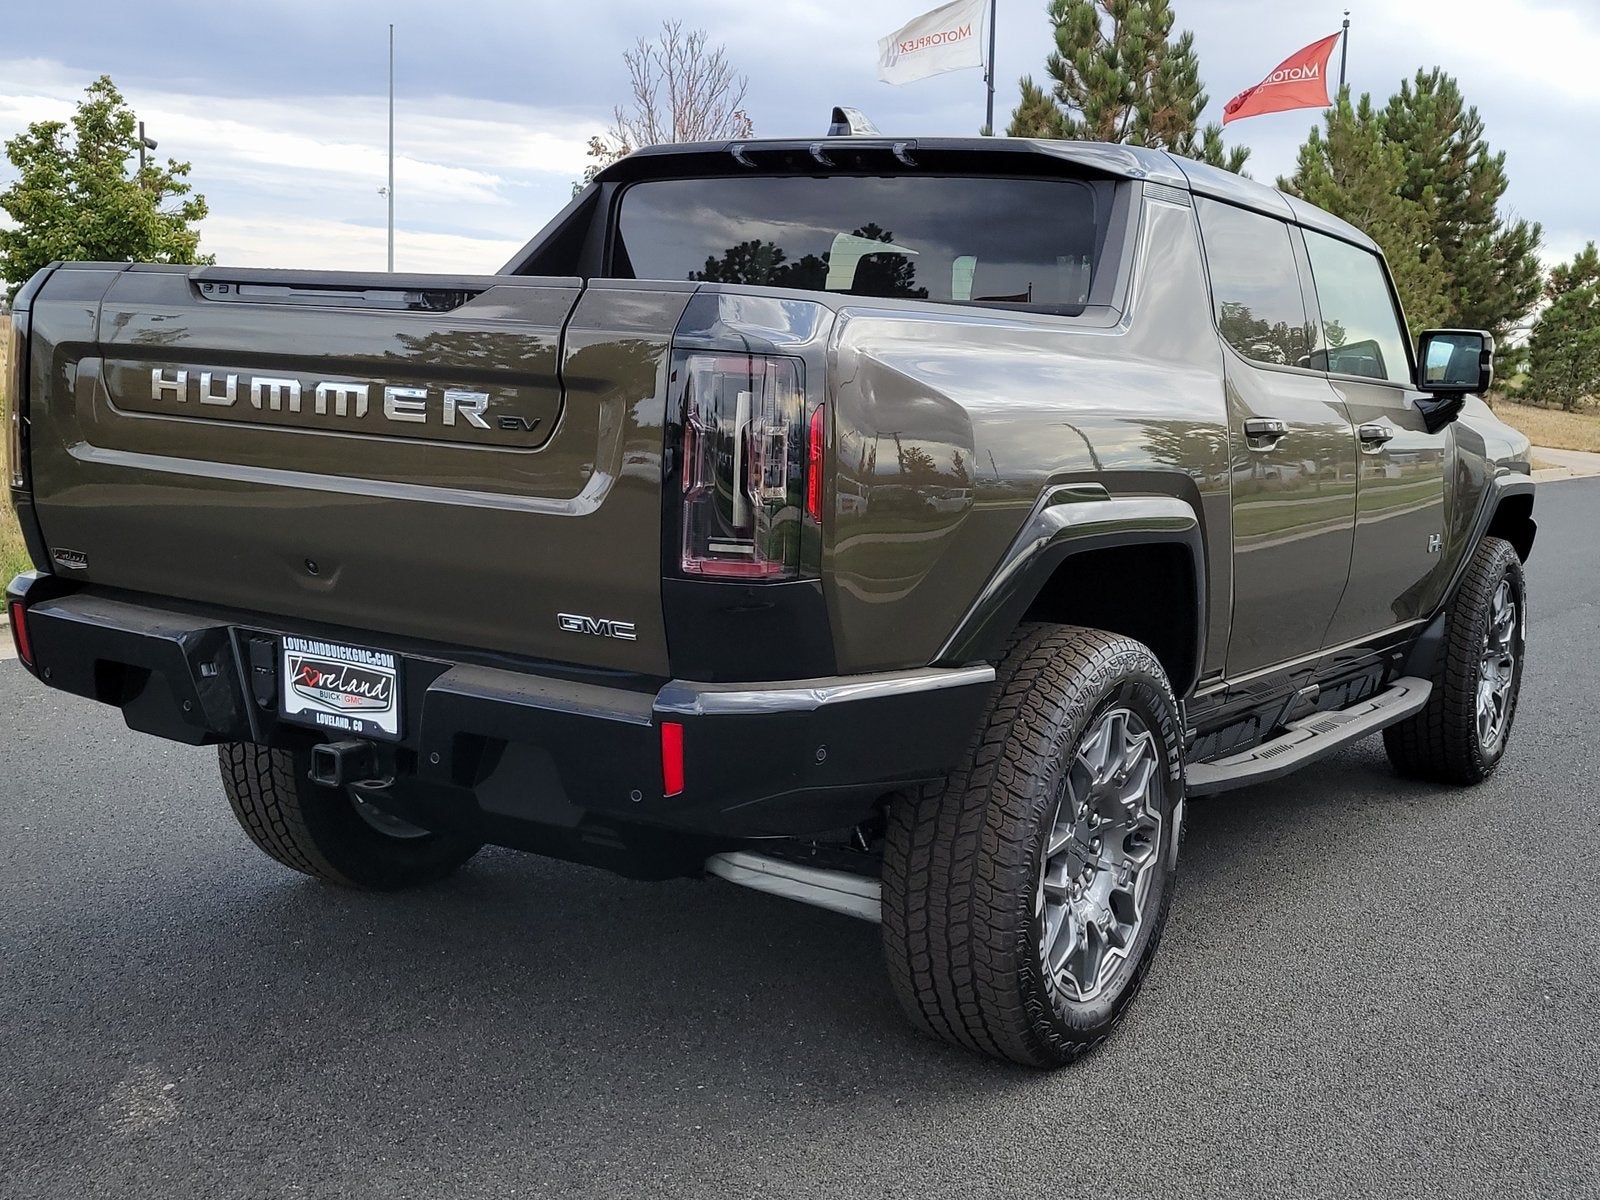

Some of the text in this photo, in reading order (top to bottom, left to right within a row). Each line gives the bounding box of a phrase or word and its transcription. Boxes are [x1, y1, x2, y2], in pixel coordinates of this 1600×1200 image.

[151, 368, 541, 431] HUMMER EV
[557, 612, 637, 641] GMC
[320, 690, 363, 705] BUICK GMC
[353, 720, 363, 732] CO
